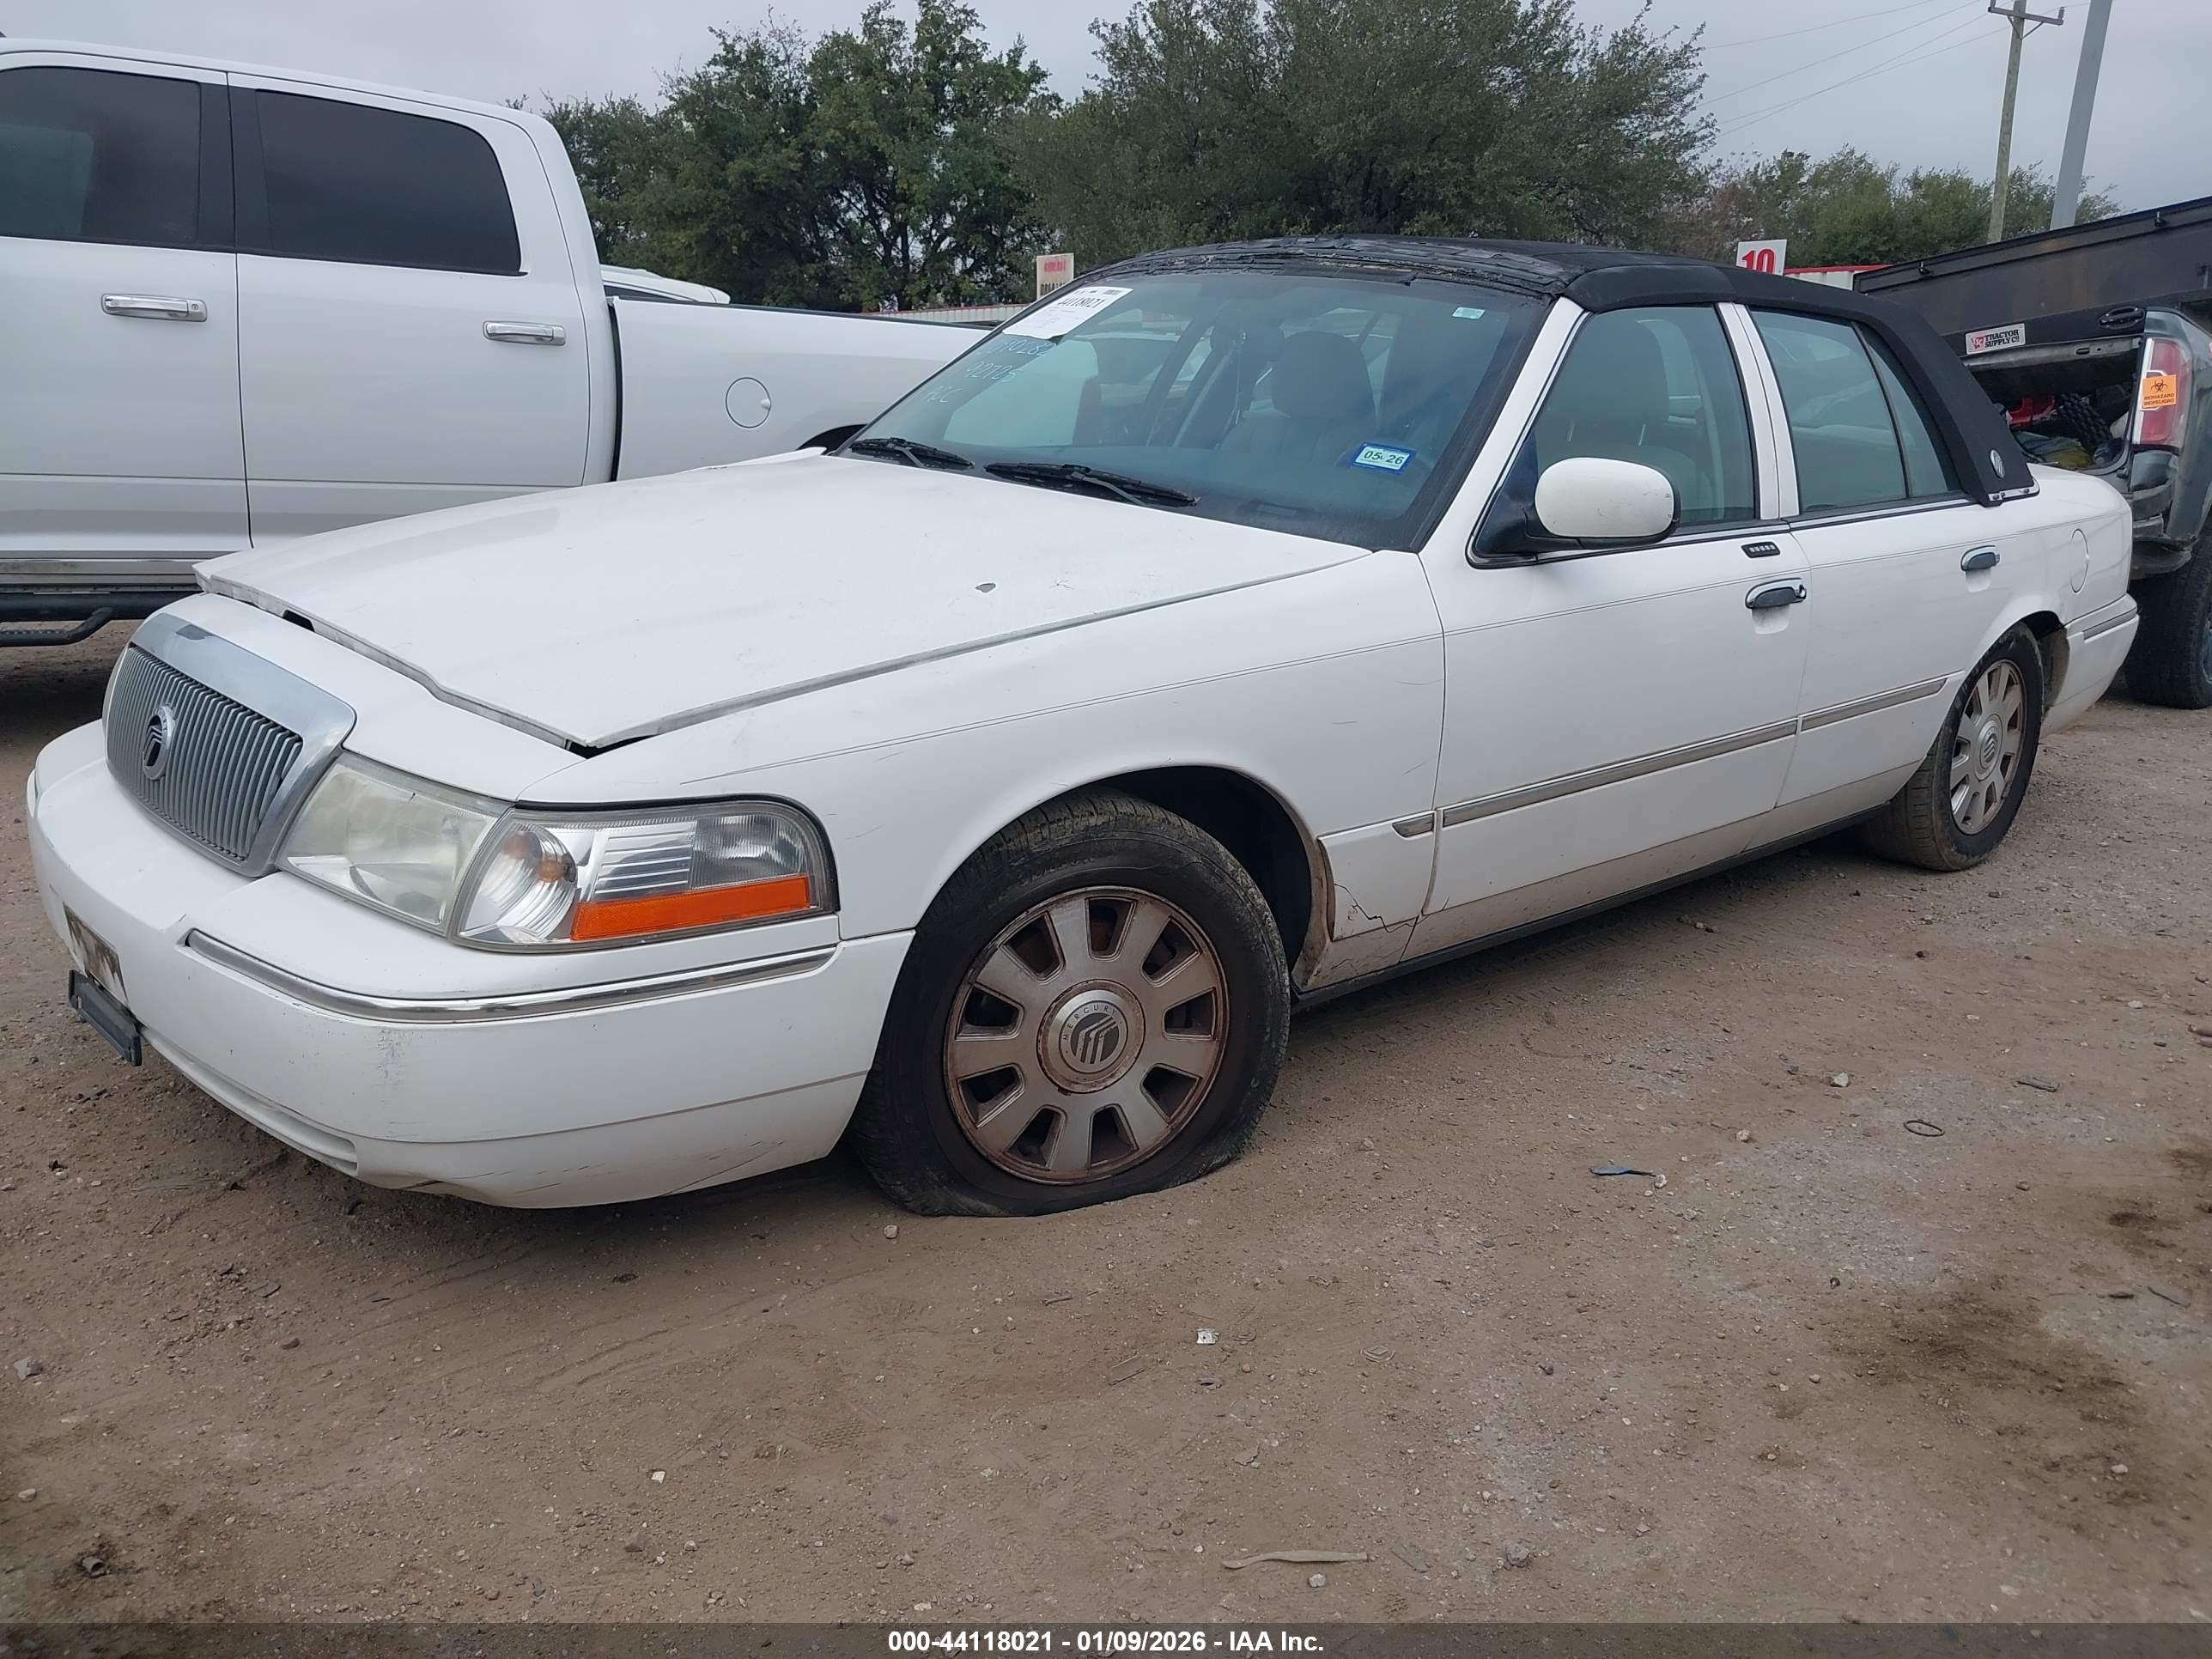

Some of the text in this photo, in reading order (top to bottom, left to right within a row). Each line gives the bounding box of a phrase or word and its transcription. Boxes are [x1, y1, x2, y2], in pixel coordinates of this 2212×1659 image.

[1741, 248, 1775, 274] 10
[1984, 329, 2019, 342] TRACTOR
[1984, 337, 2010, 348] SUPPLY
[2143, 398, 2175, 406] BIOPELIGRO
[1364, 450, 1382, 460] 05
[1385, 454, 1405, 465] 26
[1062, 1004, 1117, 1042] MERCURY
